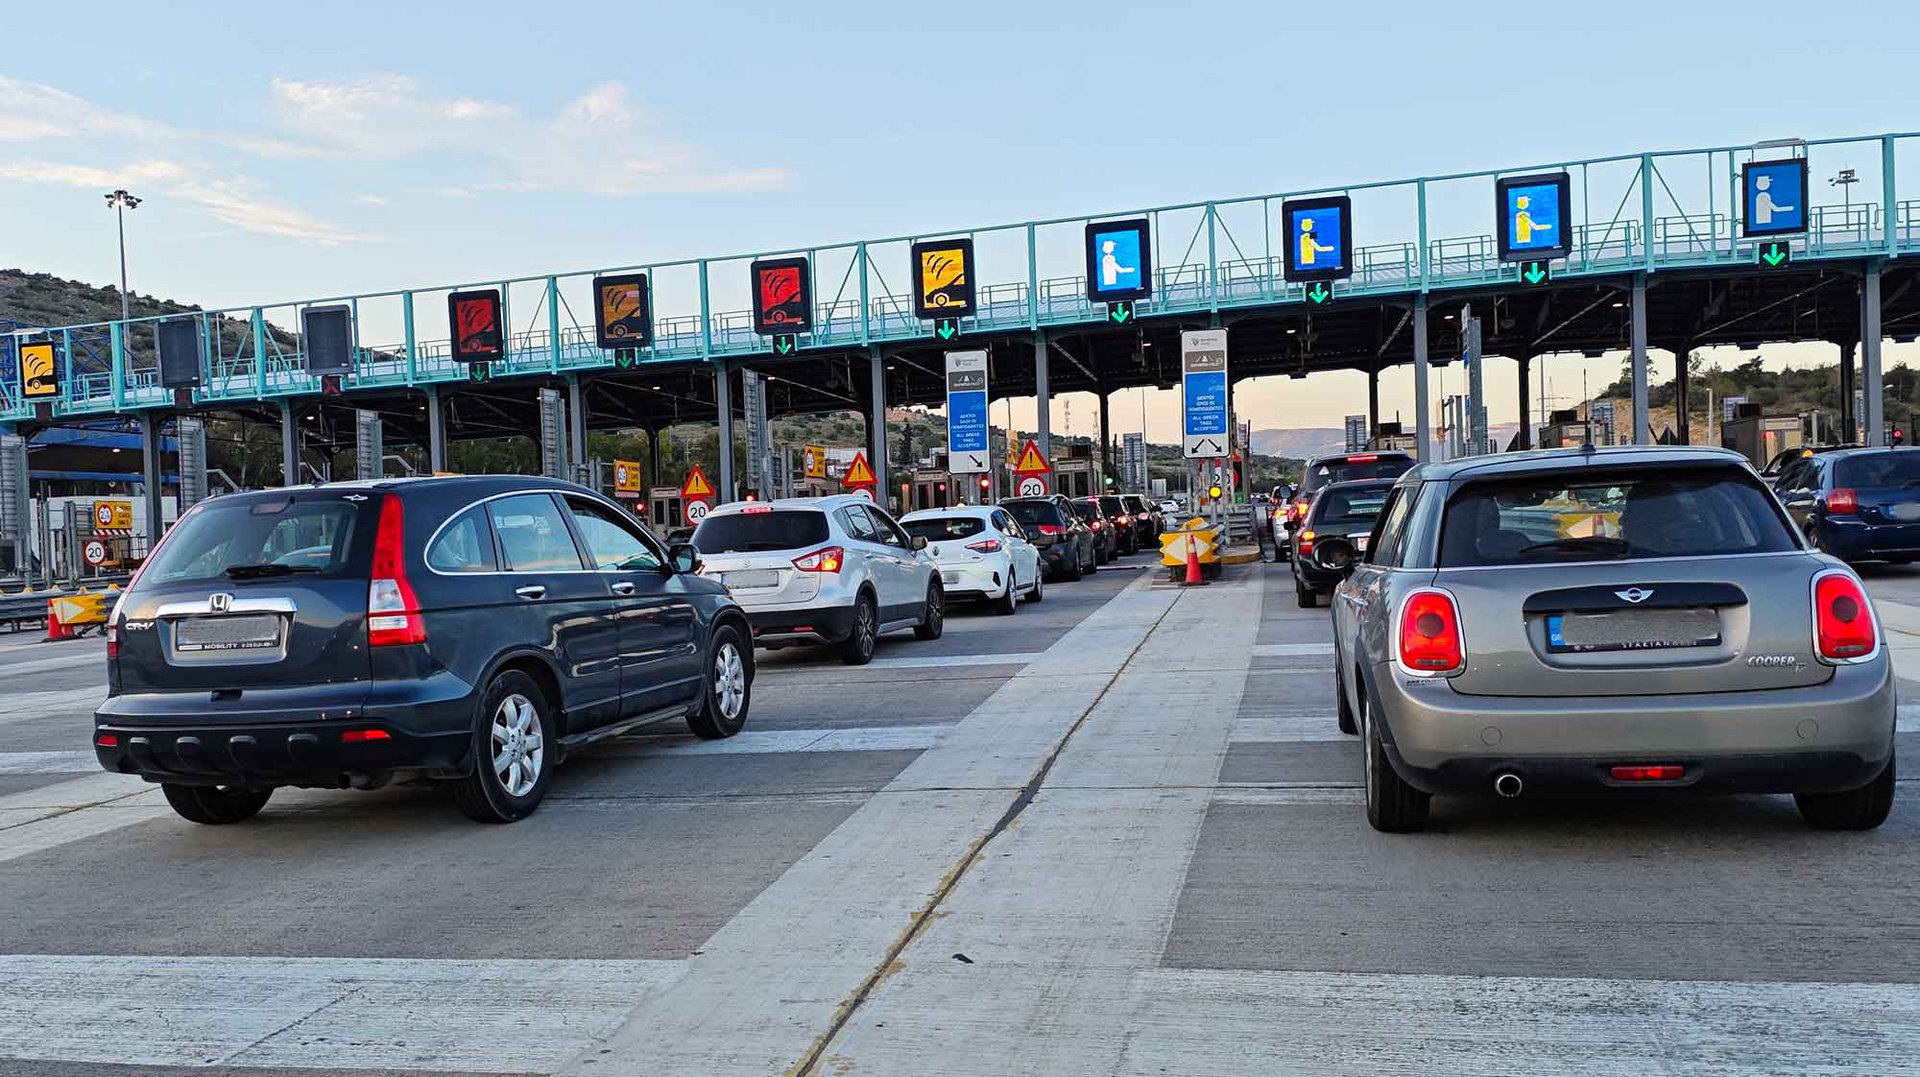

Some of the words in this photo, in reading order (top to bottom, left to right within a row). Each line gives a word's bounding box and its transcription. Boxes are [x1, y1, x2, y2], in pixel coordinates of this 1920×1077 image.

[1023, 484, 1041, 496] 20
[690, 506, 706, 518] 20
[88, 546, 102, 558] 20
[1747, 655, 1795, 667] COOPER
